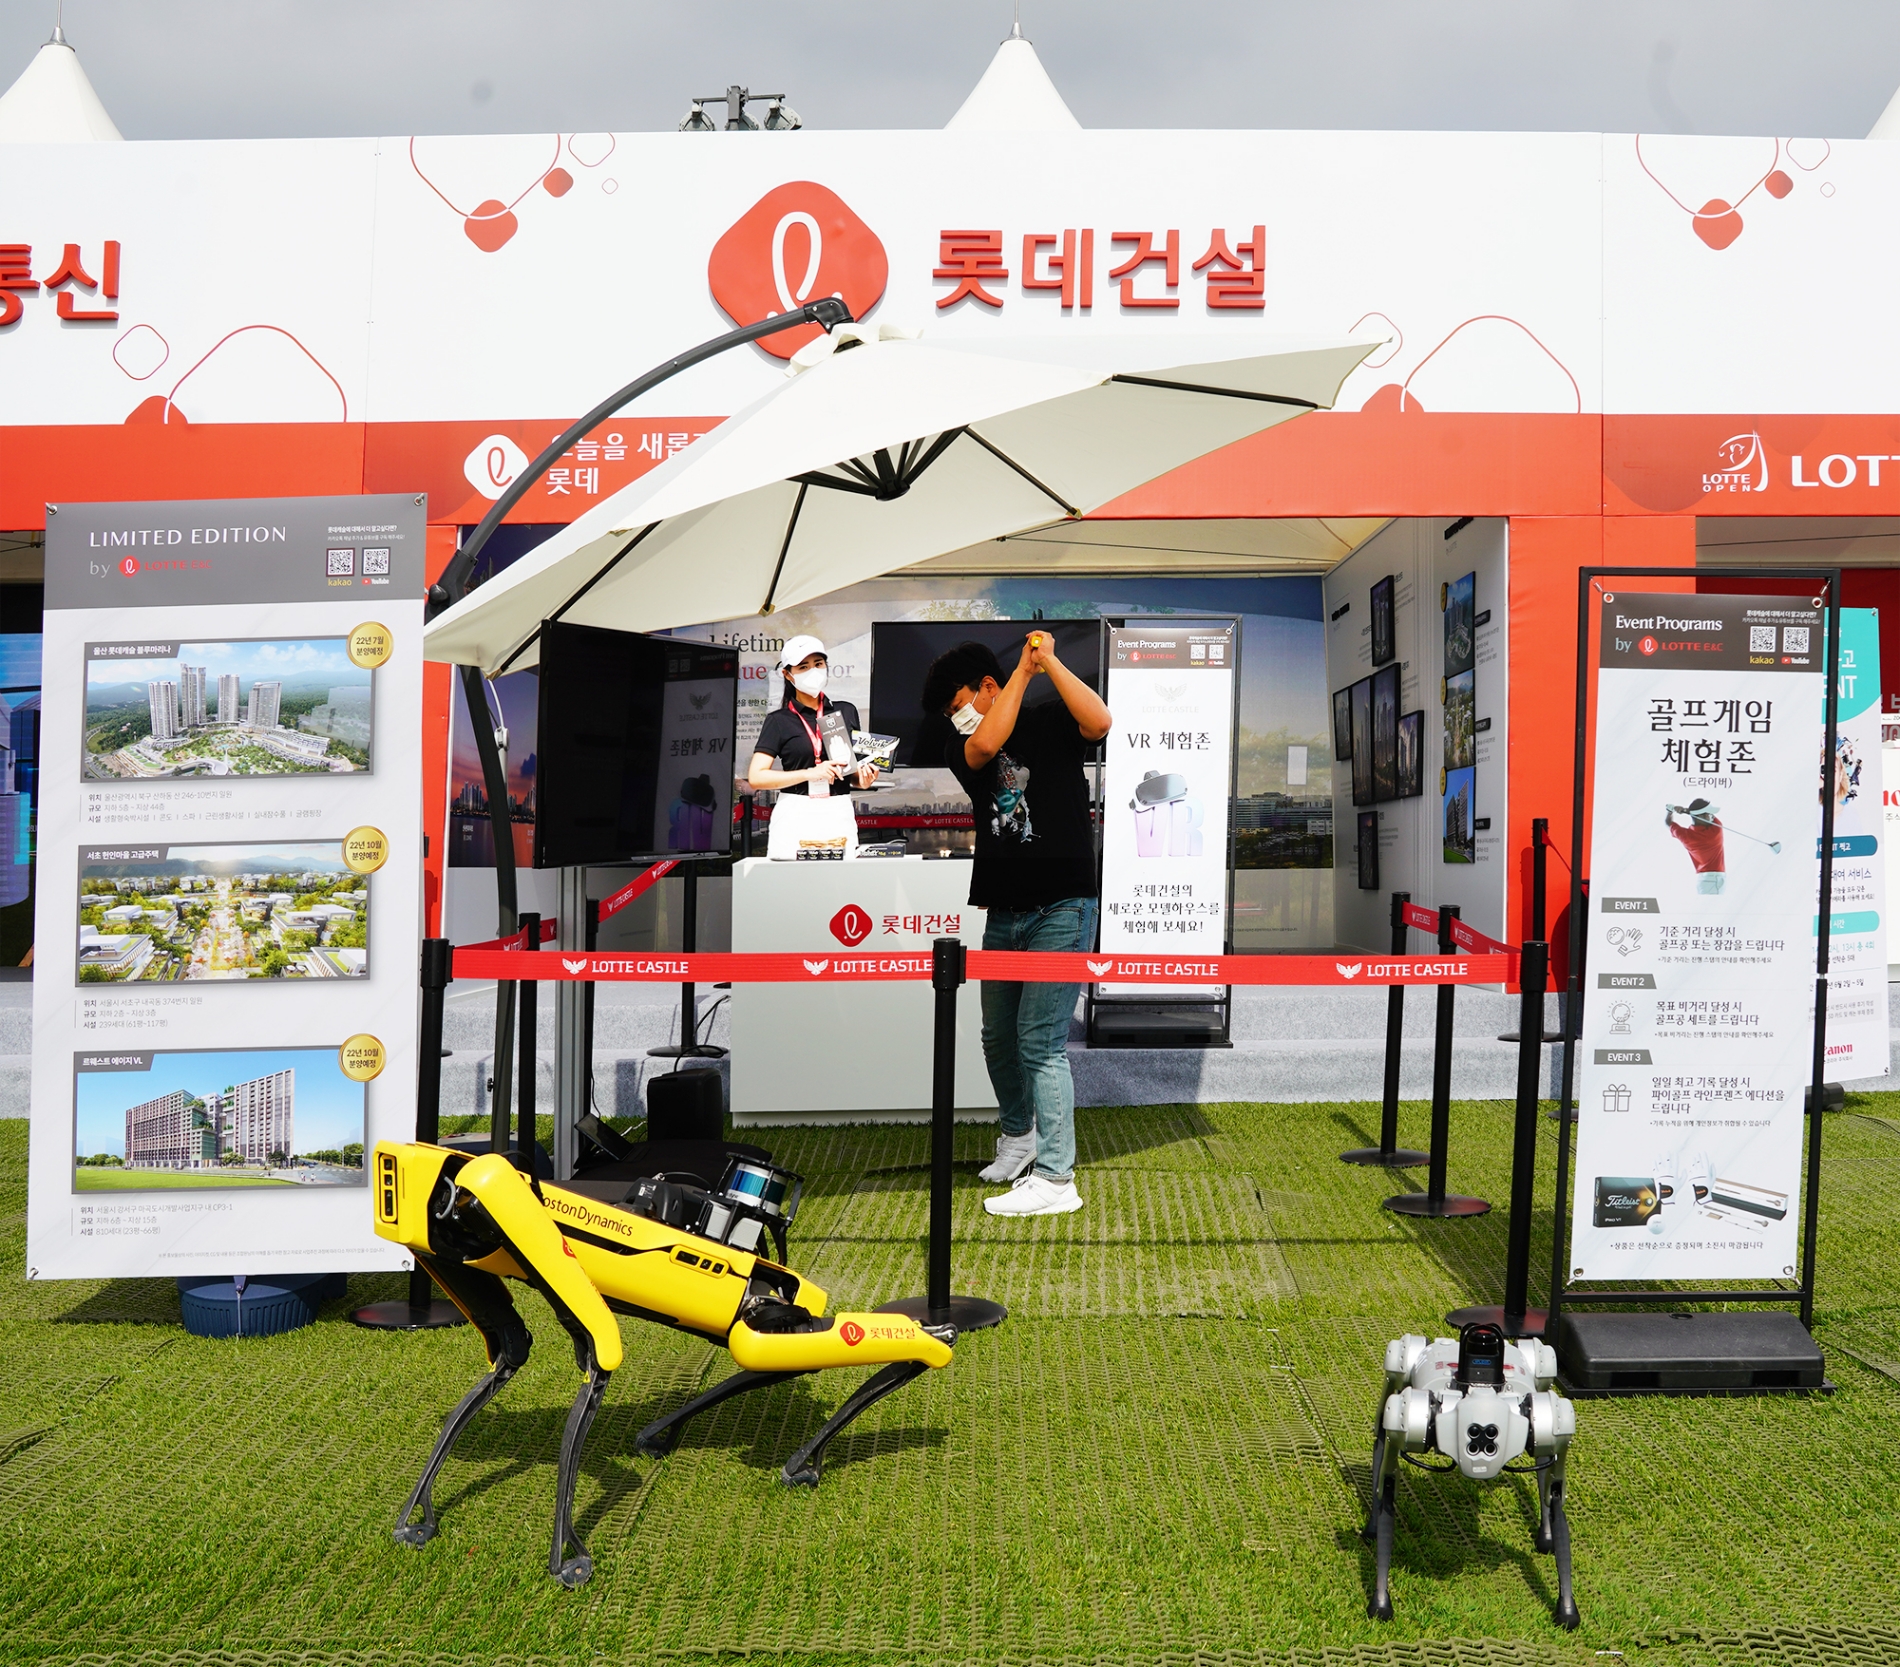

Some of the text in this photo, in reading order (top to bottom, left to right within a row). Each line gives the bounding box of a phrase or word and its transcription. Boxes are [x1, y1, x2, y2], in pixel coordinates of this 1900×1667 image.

[932, 225, 1267, 310] 롯데건설
[546, 467, 599, 495] 롯데
[1702, 473, 1750, 484] LOTTE
[1702, 484, 1751, 492] OPEN
[90, 526, 286, 547] LIMITED EDITION
[90, 560, 213, 578] by LOTTE E&C
[327, 578, 352, 586] kakao
[1615, 615, 1723, 632] Event Programs
[356, 635, 384, 645] 22년 7월
[1117, 640, 1176, 649] Event Programs
[1615, 637, 1723, 653] by LOTTE E&C
[108, 645, 136, 655] 롯데캐슬
[137, 644, 171, 655] 블루마리나
[356, 646, 384, 656] 분양예정
[1117, 652, 1127, 660] by
[1749, 655, 1775, 664] kakao
[1647, 698, 1773, 733] 골프게임
[1127, 731, 1211, 750] VR 체험존
[1660, 737, 1757, 773] 체험존
[1682, 776, 1733, 789] (드라이버)
[88, 793, 101, 801] 위치
[104, 792, 137, 801] 울산광역시
[88, 803, 165, 812] 규모 지하 5층 지상 44층
[87, 815, 101, 823] 시설
[349, 840, 382, 850] 22년 10월
[87, 851, 101, 860] 서초
[130, 850, 159, 860] 고급주택
[352, 851, 379, 861] 분양예정
[1847, 867, 1872, 881] 서비스
[1132, 884, 1193, 897] 롯데건설의
[1107, 902, 1220, 915] 새로운 모델하우스를
[1615, 901, 1648, 910] EVENT 1
[882, 914, 961, 934] 롯데건설
[1122, 920, 1204, 934] 체험해 보세요!
[1660, 926, 1736, 938] 기준 거리 달성 시
[1659, 939, 1785, 951] 골프공 또는 장갑을 드립니다
[591, 960, 689, 974] LOTTE CASTLE
[833, 958, 934, 973] LOTTE CASTLE
[1117, 962, 1219, 976] LOTTE CASTLE
[1367, 963, 1468, 976] LOTTE CASTLE
[1611, 977, 1645, 986] EVENT 2
[83, 999, 97, 1007] 위치
[100, 998, 120, 1007] 서울시
[120, 998, 141, 1007] 서초구
[162, 997, 188, 1006] 374번지
[1656, 1001, 1742, 1013] 목표 비거리 달성 시
[83, 1008, 156, 1018] 규모 지하 2층 지상 3층
[83, 1020, 125, 1029] 시설 239세대
[1655, 1014, 1759, 1026] 골프공 세트를 드립니다
[346, 1048, 379, 1058] 22년 10월
[1607, 1053, 1641, 1062] EVENT 3
[111, 1056, 133, 1065] 에이지
[133, 1056, 143, 1065] VL
[349, 1059, 376, 1069] 분양예정
[1651, 1077, 1750, 1089] 일일 최고 기록 달성 시
[1651, 1090, 1785, 1101] 파이골프 라인프렌즈 에디션을
[1650, 1103, 1691, 1114] 드립니다
[1605, 1194, 1640, 1207] Titleist
[80, 1206, 94, 1214] 위치
[96, 1205, 116, 1214] 서울시
[117, 1205, 137, 1214] 강서구
[80, 1216, 157, 1225] 규모 지하 6층 지상 15층
[543, 1196, 634, 1237] ostonDynamics
[80, 1227, 122, 1236] 시설 810세대
[1614, 1241, 1635, 1250] 상품은
[1705, 1242, 1727, 1250] 소진시
[1728, 1241, 1764, 1250] 마감됩니다
[870, 1327, 916, 1340] 롯데건설
